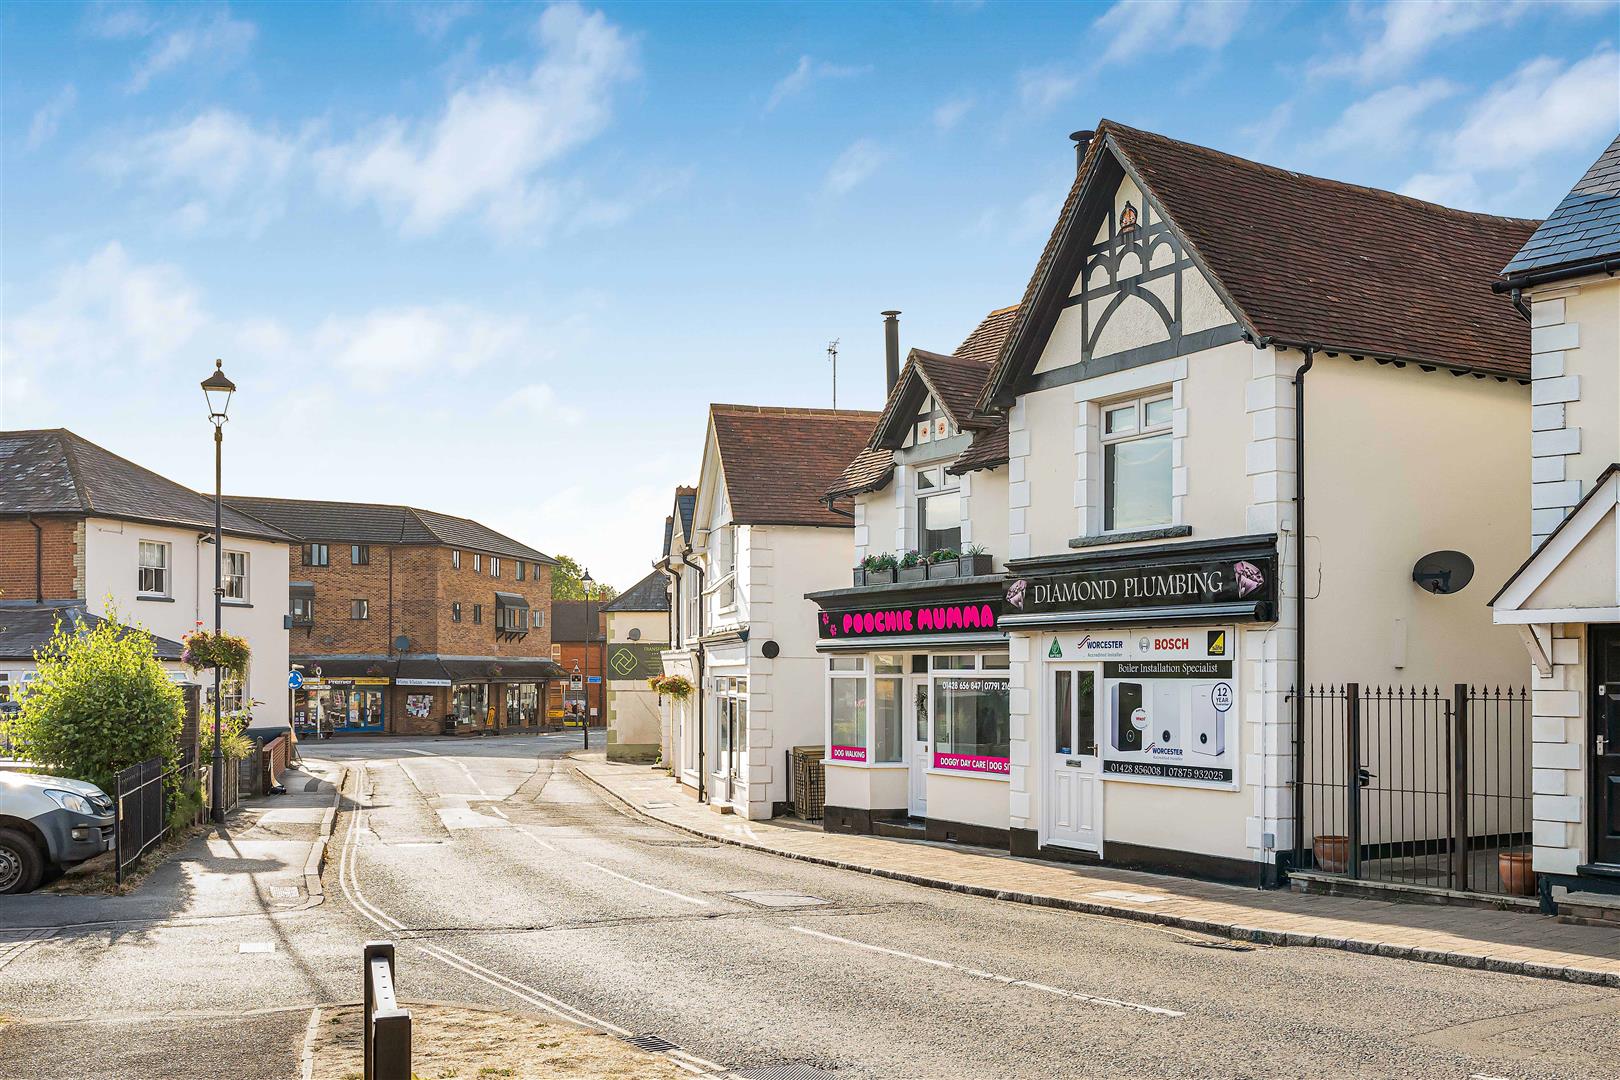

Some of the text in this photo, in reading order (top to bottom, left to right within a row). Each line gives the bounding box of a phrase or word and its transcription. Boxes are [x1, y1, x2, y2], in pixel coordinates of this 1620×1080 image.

[1034, 571, 1223, 604] DIAMOND PLUMBING
[842, 604, 994, 634] POOCHIE MUMMA
[1086, 640, 1123, 649] WORCESTER
[1154, 638, 1189, 650] BOSCH
[1118, 662, 1218, 675] Boiler Installation Specialist
[942, 681, 958, 690] 01428
[959, 682, 970, 690] 656
[970, 682, 981, 690] 847
[984, 682, 1000, 690] 07791
[1217, 687, 1228, 697] 12
[845, 750, 865, 758] WALKING
[1152, 748, 1184, 756] WORCESTER
[940, 758, 959, 766] DOGGY
[972, 760, 986, 769] CARE
[989, 761, 1002, 770] DOG
[1110, 763, 1224, 780] 01428 856008 07875 932025
